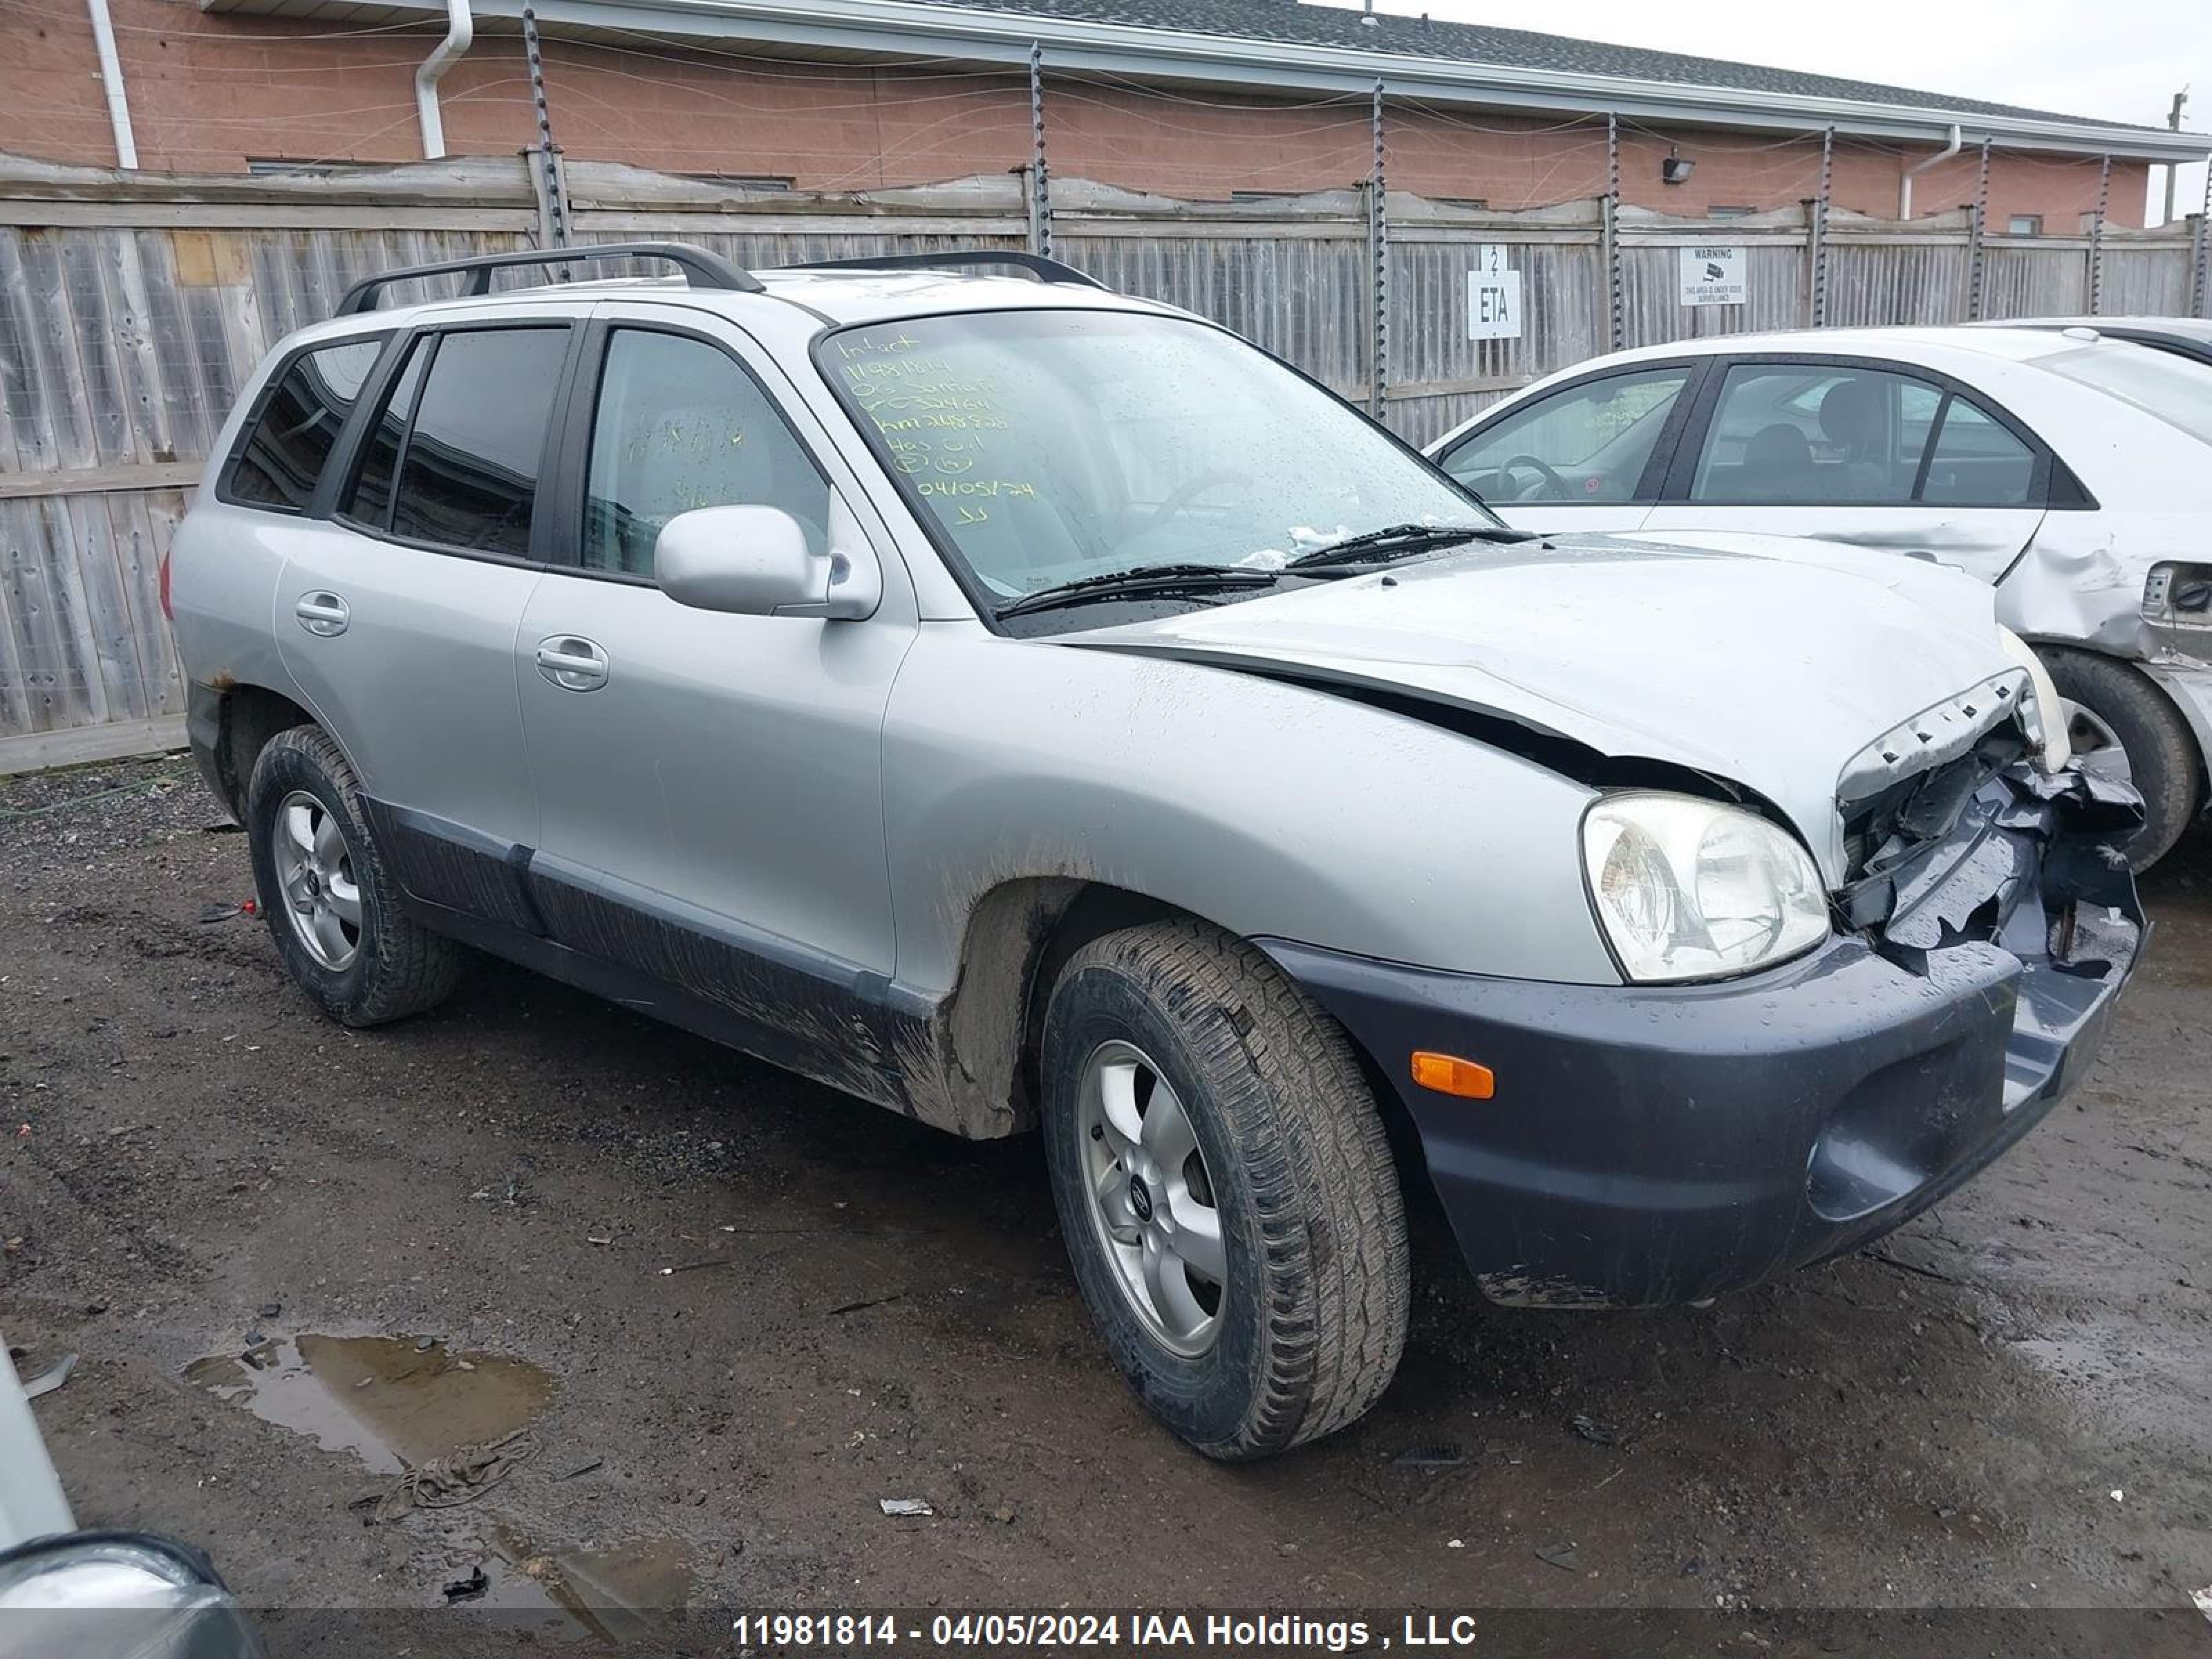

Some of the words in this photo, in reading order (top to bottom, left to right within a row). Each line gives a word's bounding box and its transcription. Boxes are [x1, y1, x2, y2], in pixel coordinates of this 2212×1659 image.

[1490, 251, 1499, 272] 2
[1694, 248, 1732, 259] WARNING
[1480, 287, 1509, 323] ETA
